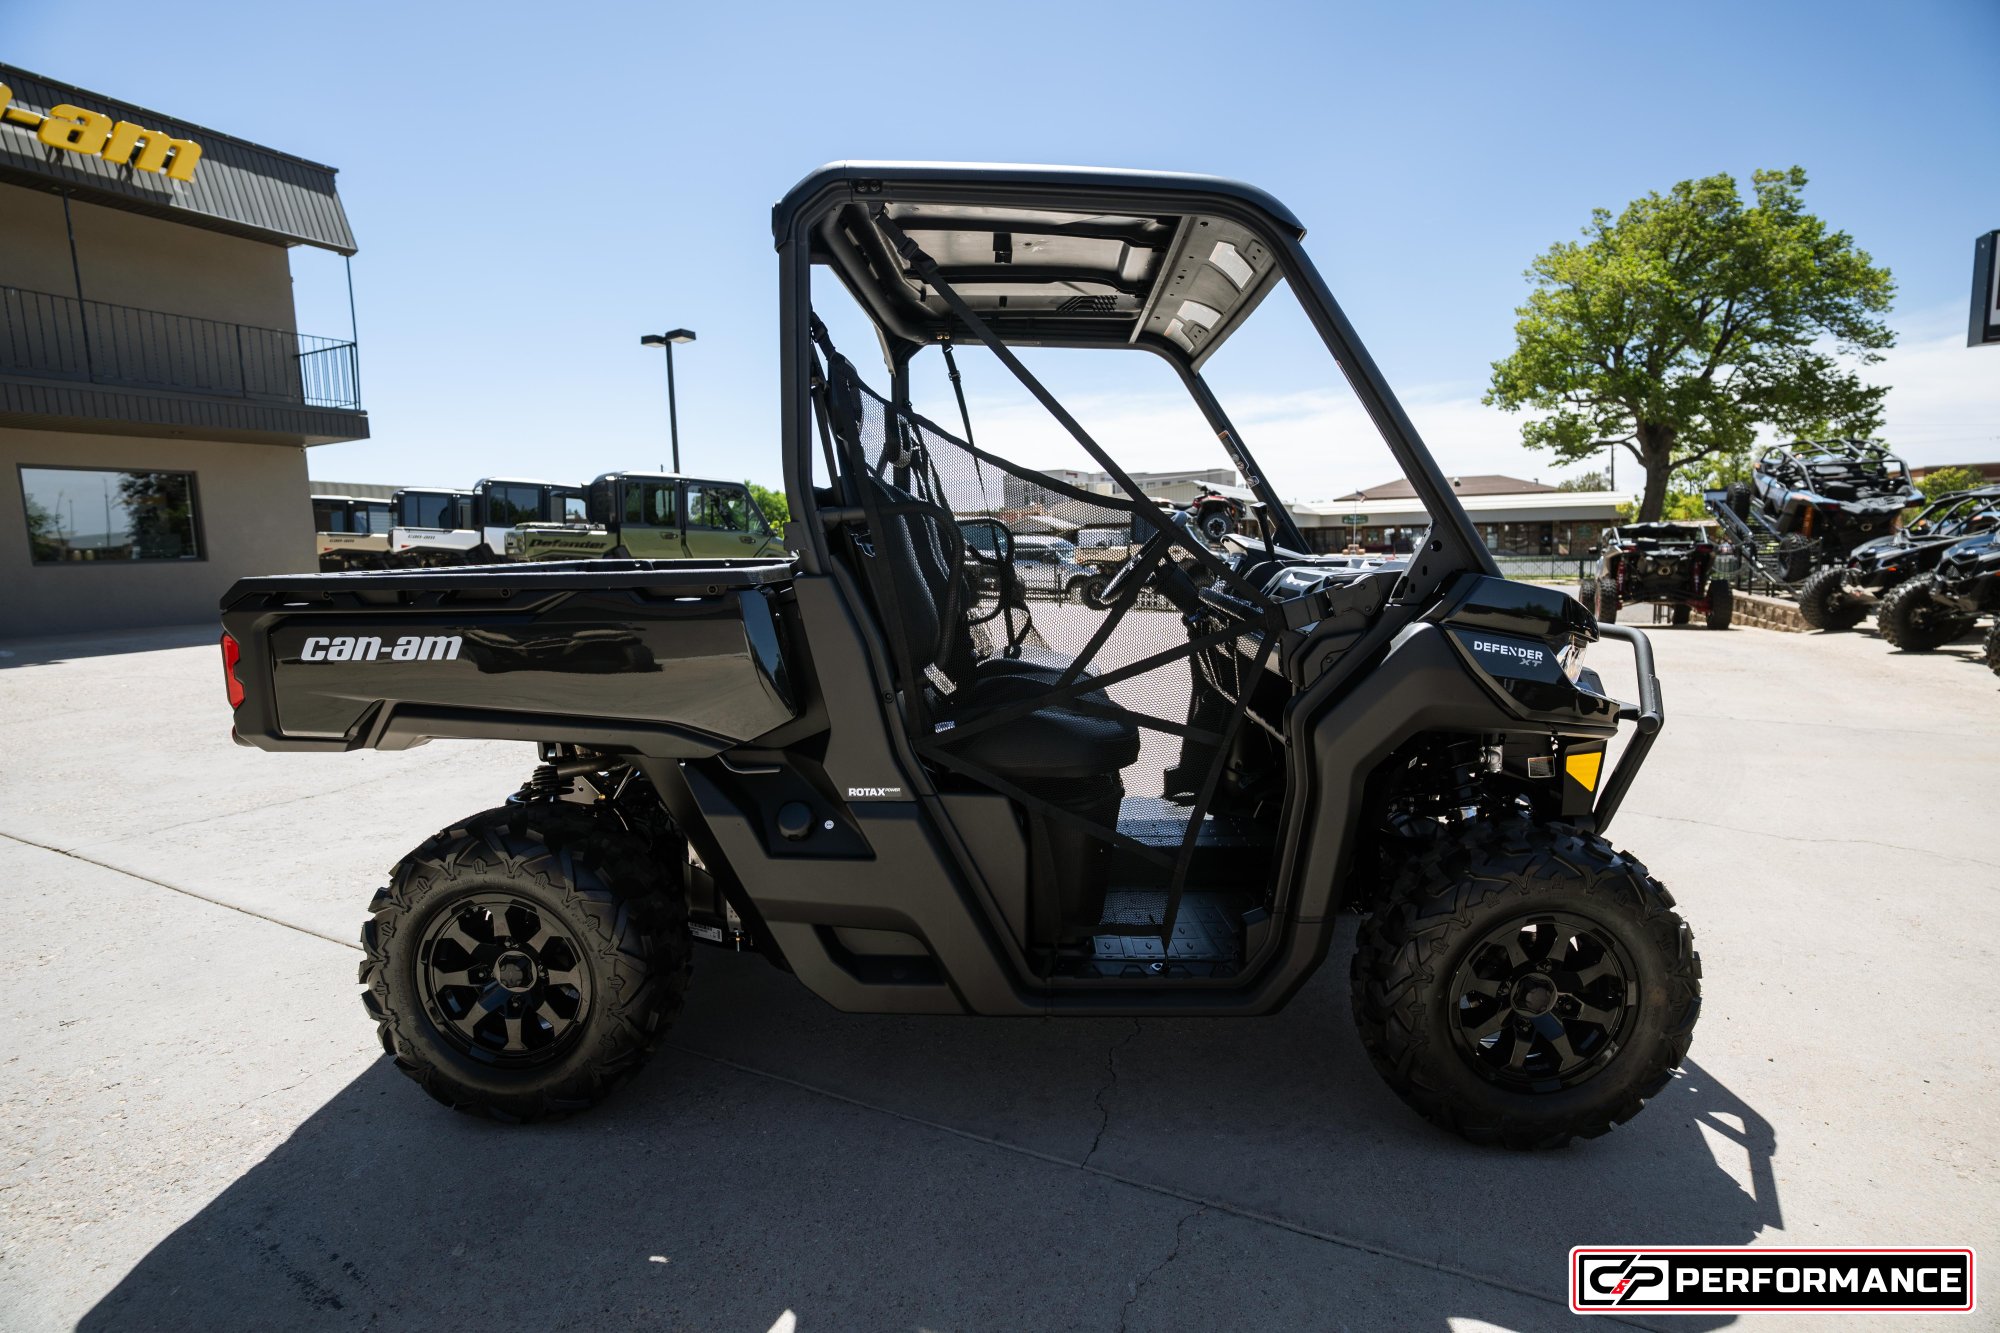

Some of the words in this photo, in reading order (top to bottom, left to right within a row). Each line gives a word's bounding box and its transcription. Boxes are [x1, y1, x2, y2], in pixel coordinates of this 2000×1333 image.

[0, 81, 203, 182] -am
[301, 635, 462, 661] can-am
[1473, 640, 1544, 661] DEFENDER
[1519, 658, 1543, 667] XT
[848, 787, 885, 797] ROTAX
